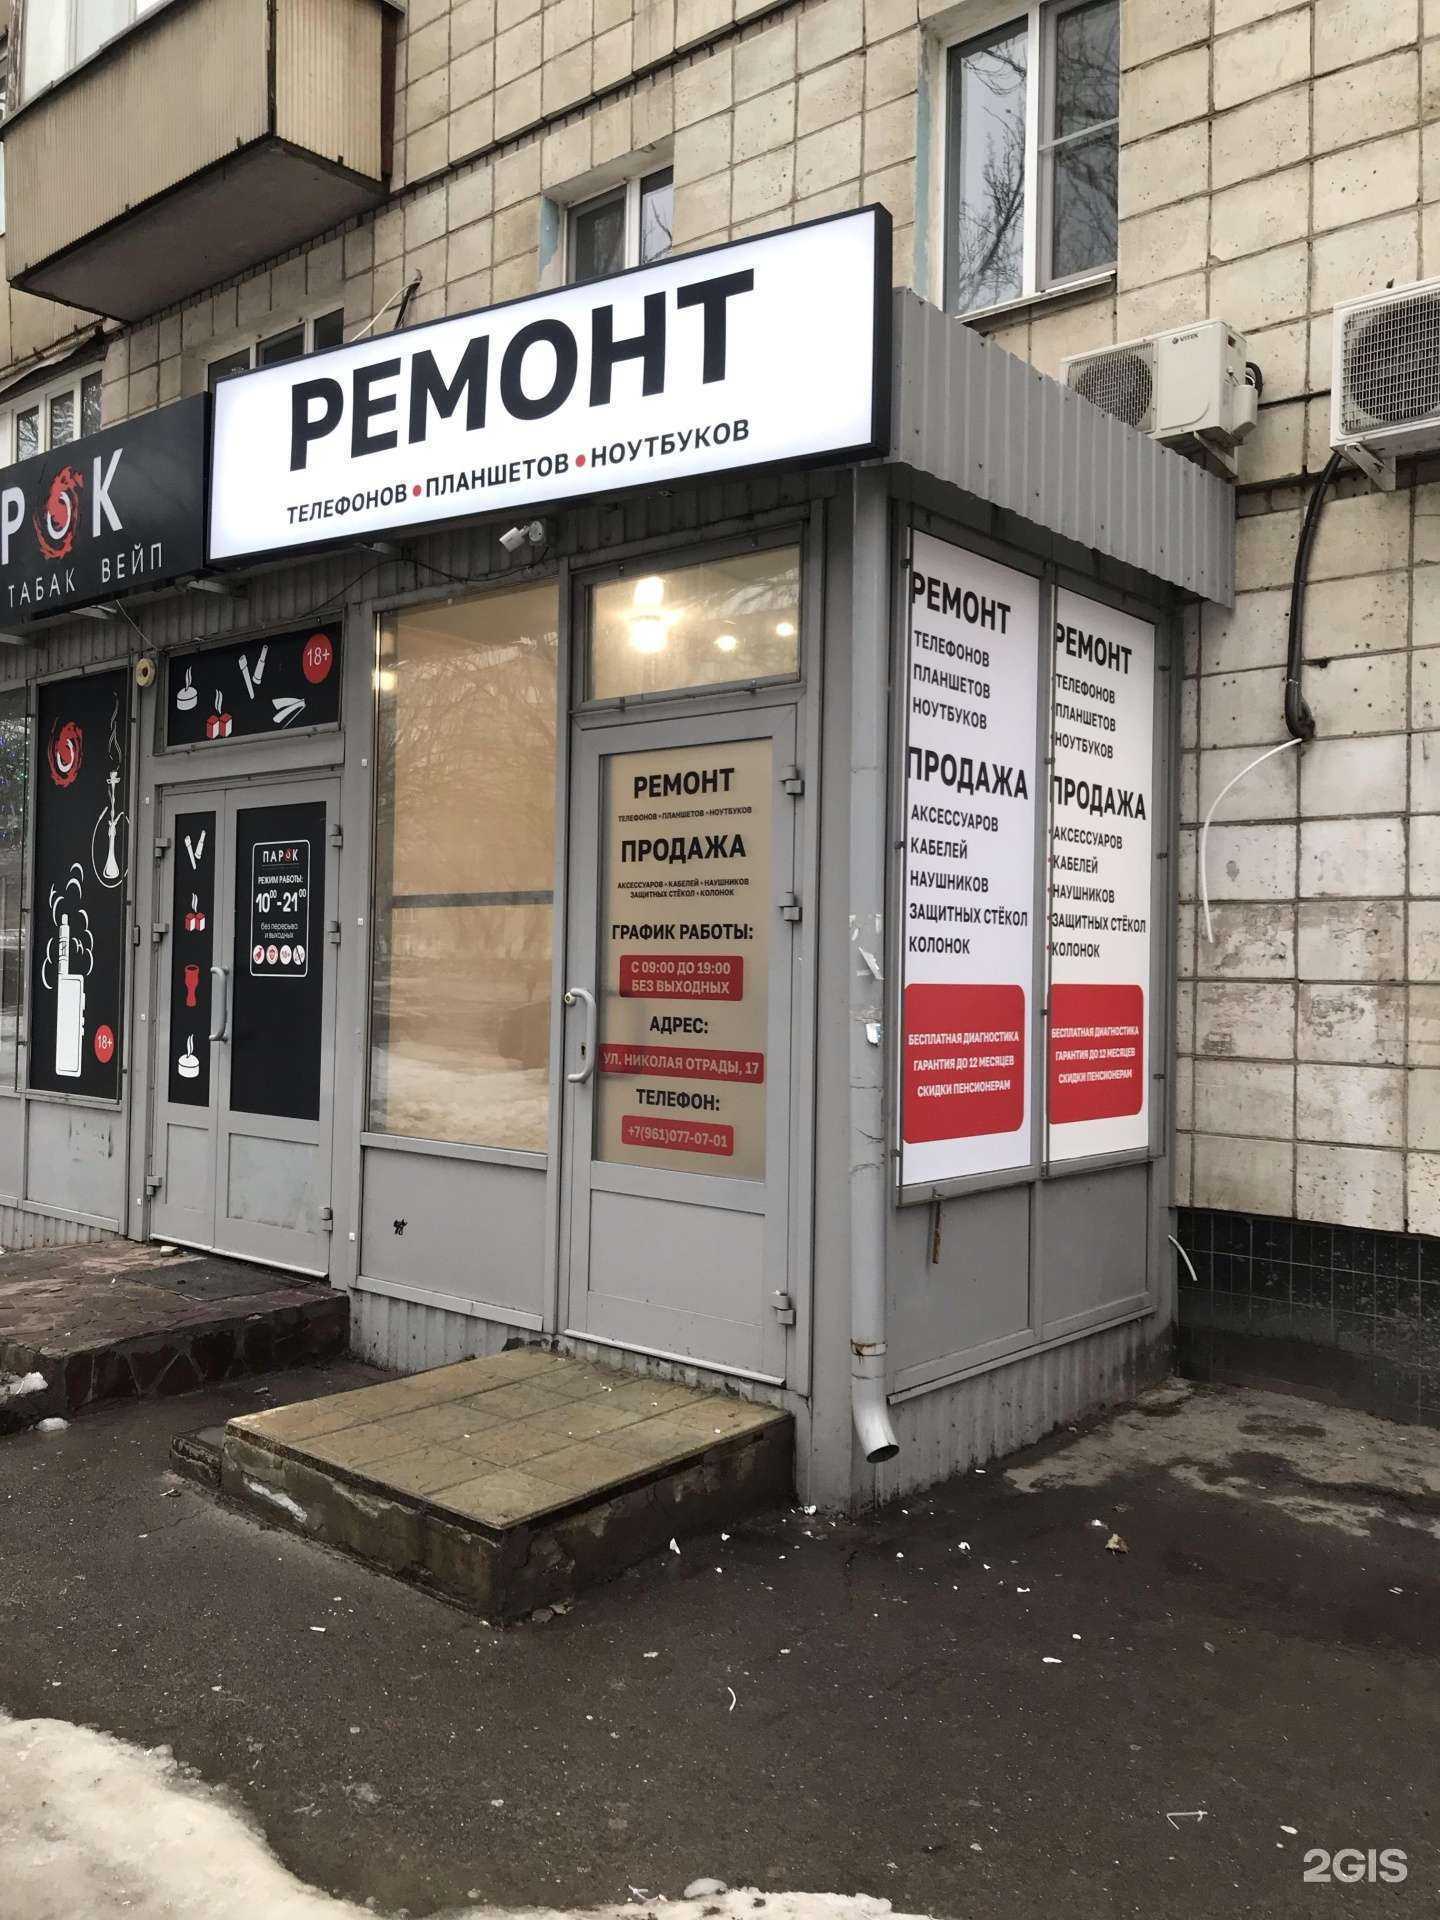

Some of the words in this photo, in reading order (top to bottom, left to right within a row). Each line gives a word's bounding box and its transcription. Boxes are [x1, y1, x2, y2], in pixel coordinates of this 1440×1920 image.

[290, 268, 754, 472] РЕМОНТ
[287, 483, 408, 524] ТЕЛЕФОНОВ
[426, 452, 569, 498] ПЛАНШЕТОВ
[590, 418, 749, 468] НОУТБУКОВ
[8, 568, 76, 608] ТАБАК
[101, 542, 162, 583] ВЕЙП
[912, 571, 1011, 634] РЕМОНТ
[306, 646, 331, 667] 18+
[914, 630, 990, 667] ТЕЛЕФОНОВ
[1056, 622, 1132, 674] РЕМОНТ
[913, 664, 991, 699] ПЛАНШЕТОВ
[1056, 673, 1115, 704] ТЕЛЕФОНОВ
[912, 697, 988, 729] НОУТБУКОВ
[1056, 703, 1116, 732] ПЛАНШЕТОВ
[1055, 732, 1114, 759] НОУТБУКОВ
[634, 768, 735, 799] РЕМОНТ
[907, 746, 1029, 800] ПРОДАЖА
[1051, 775, 1147, 820] ПРОДАЖА
[618, 813, 658, 823] ТЕЛЕФОНОВ
[662, 810, 704, 820] ПЛАНШЕТОВ
[709, 806, 753, 816] НОУТБУКОВ
[911, 804, 999, 832] АКСЕССУАРОВ
[621, 833, 747, 865] ПРОДАЖА
[910, 837, 968, 859] КАБЕЛЕЙ
[1053, 826, 1123, 850] АКСЕССУАРОВ
[1053, 855, 1098, 874] КАБЕЛЕЙ
[258, 876, 279, 885] РЕЖИМ
[617, 880, 664, 889] АКСЕССУАРОВ
[668, 878, 699, 888] КАБЕЛЕЙ
[704, 878, 749, 887] НАУШНИКОВ
[910, 870, 989, 893] НАУШНИКОВ
[630, 890, 667, 899] ЗАЩИТНЫХ
[668, 888, 695, 898] СТЁКОЛ
[700, 889, 734, 897] КОЛОНОК
[1052, 883, 1115, 904] НАУШНИКОВ
[909, 902, 981, 924] ЗАЩИТНЫХ
[984, 907, 1028, 926] СТЁКОЛ
[1051, 913, 1109, 931] ЗАЩИТНЫХ
[1110, 915, 1146, 933] СТЁКОЛ
[612, 924, 675, 940] ГРАФИК
[679, 923, 753, 940] РАБОТЫ:
[909, 936, 970, 955] КОЛОНОК
[1052, 941, 1100, 958] КОЛОНОК
[631, 961, 640, 973] С
[641, 962, 674, 974] 09:00
[677, 962, 695, 976] ДО
[697, 962, 731, 975] 19:00
[631, 980, 655, 992] БЕЗ
[656, 981, 730, 994] ВЫХОДНЫХ
[649, 1016, 708, 1034] АДРЕС:
[1051, 1027, 1094, 1038] БЕСПЛАТНАЯ
[1094, 1026, 1139, 1038] ДИАГНОСТИКА
[97, 1035, 113, 1049] 18+
[908, 1033, 963, 1045] БЕСПЛАТНАЯ
[963, 1031, 1020, 1044] ДИАГНОСТИКА
[603, 1053, 622, 1065] УЛ.
[625, 1055, 684, 1070] НИКОЛАЯ
[686, 1058, 742, 1075] ОТРАДЫ,
[745, 1062, 759, 1074] 17
[913, 1058, 956, 1072] ГАРАНТИЯ
[956, 1058, 968, 1070] ДО
[969, 1057, 978, 1068] 12
[979, 1055, 1015, 1068] МЕСЯЦЕВ
[1055, 1050, 1089, 1061] ГАРАНТИЯ
[1089, 1049, 1099, 1060] ДО
[1099, 1049, 1107, 1059] 12
[1107, 1047, 1136, 1058] МЕСЯЦЕВ
[1058, 1072, 1086, 1084] СКИДКИ
[1086, 1069, 1133, 1082] ПЕНСИОНЕРАМ
[636, 1088, 720, 1111] ТЕЛЕФОН:
[917, 1084, 953, 1097] СКИДКИ
[953, 1080, 1011, 1094] ПЕНСИОНЕРАМ
[628, 1125, 728, 1148] +7(961)077-07-01
